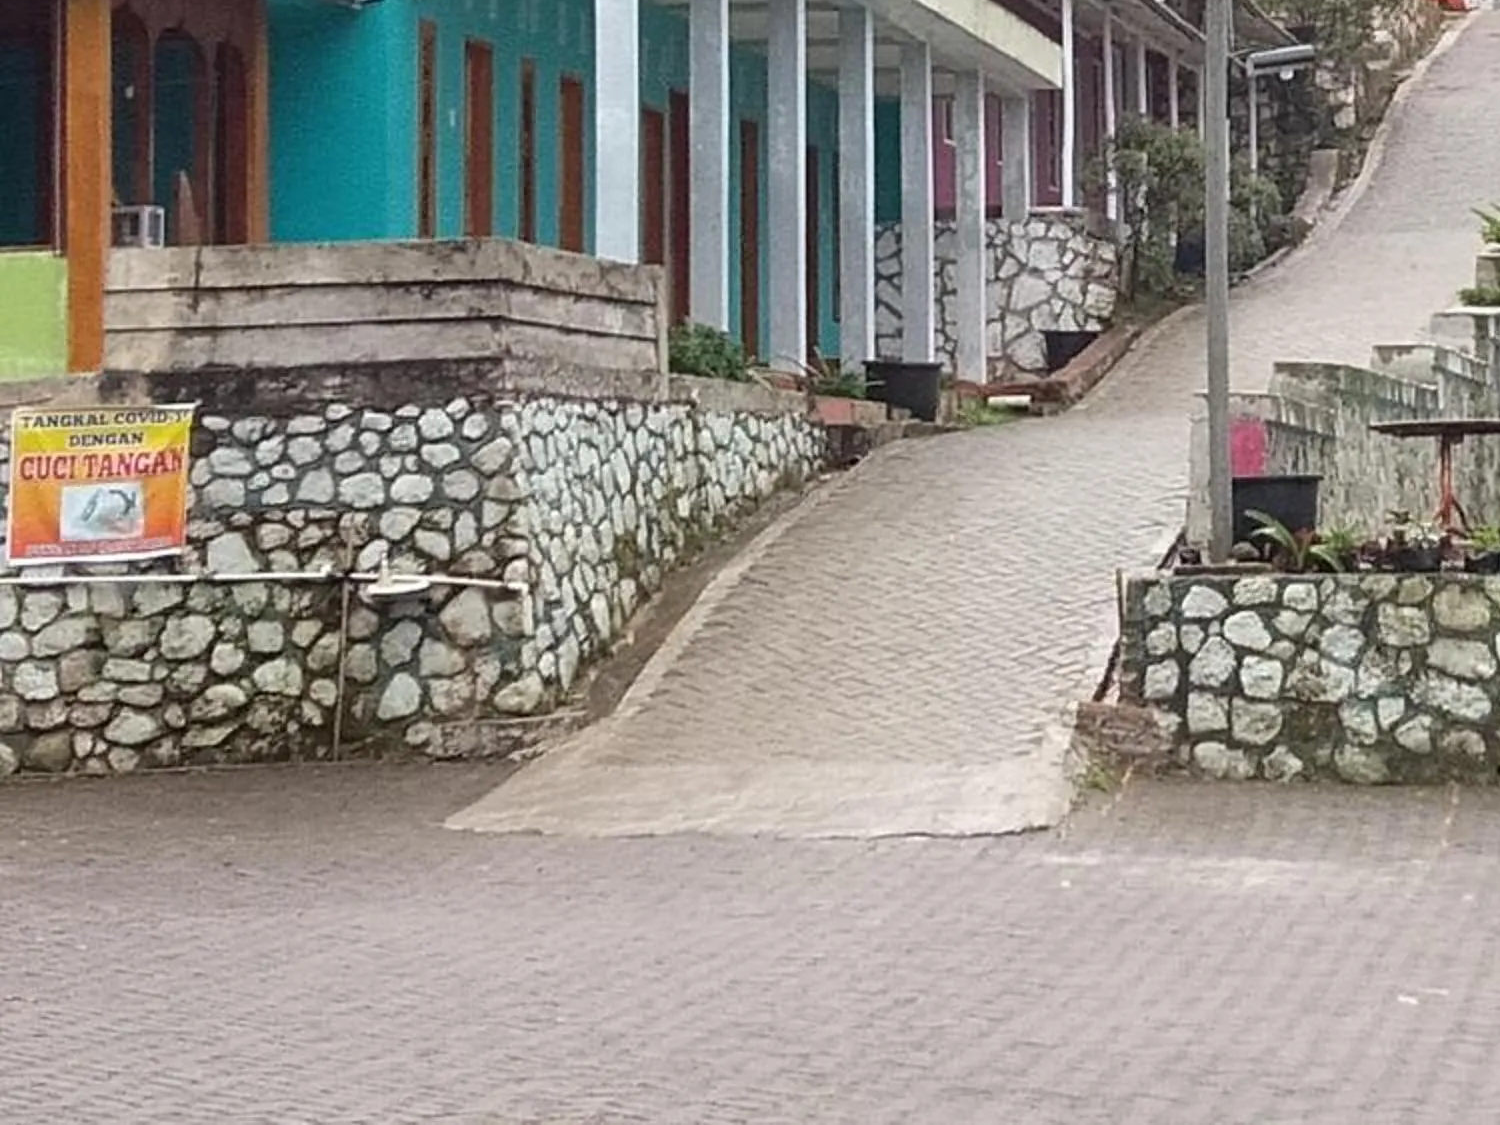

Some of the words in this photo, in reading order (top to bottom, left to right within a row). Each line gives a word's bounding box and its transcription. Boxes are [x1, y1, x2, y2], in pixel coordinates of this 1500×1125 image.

[19, 413, 109, 428] TANGKAL
[69, 432, 144, 447] DENGAN
[20, 455, 77, 480] CUCI
